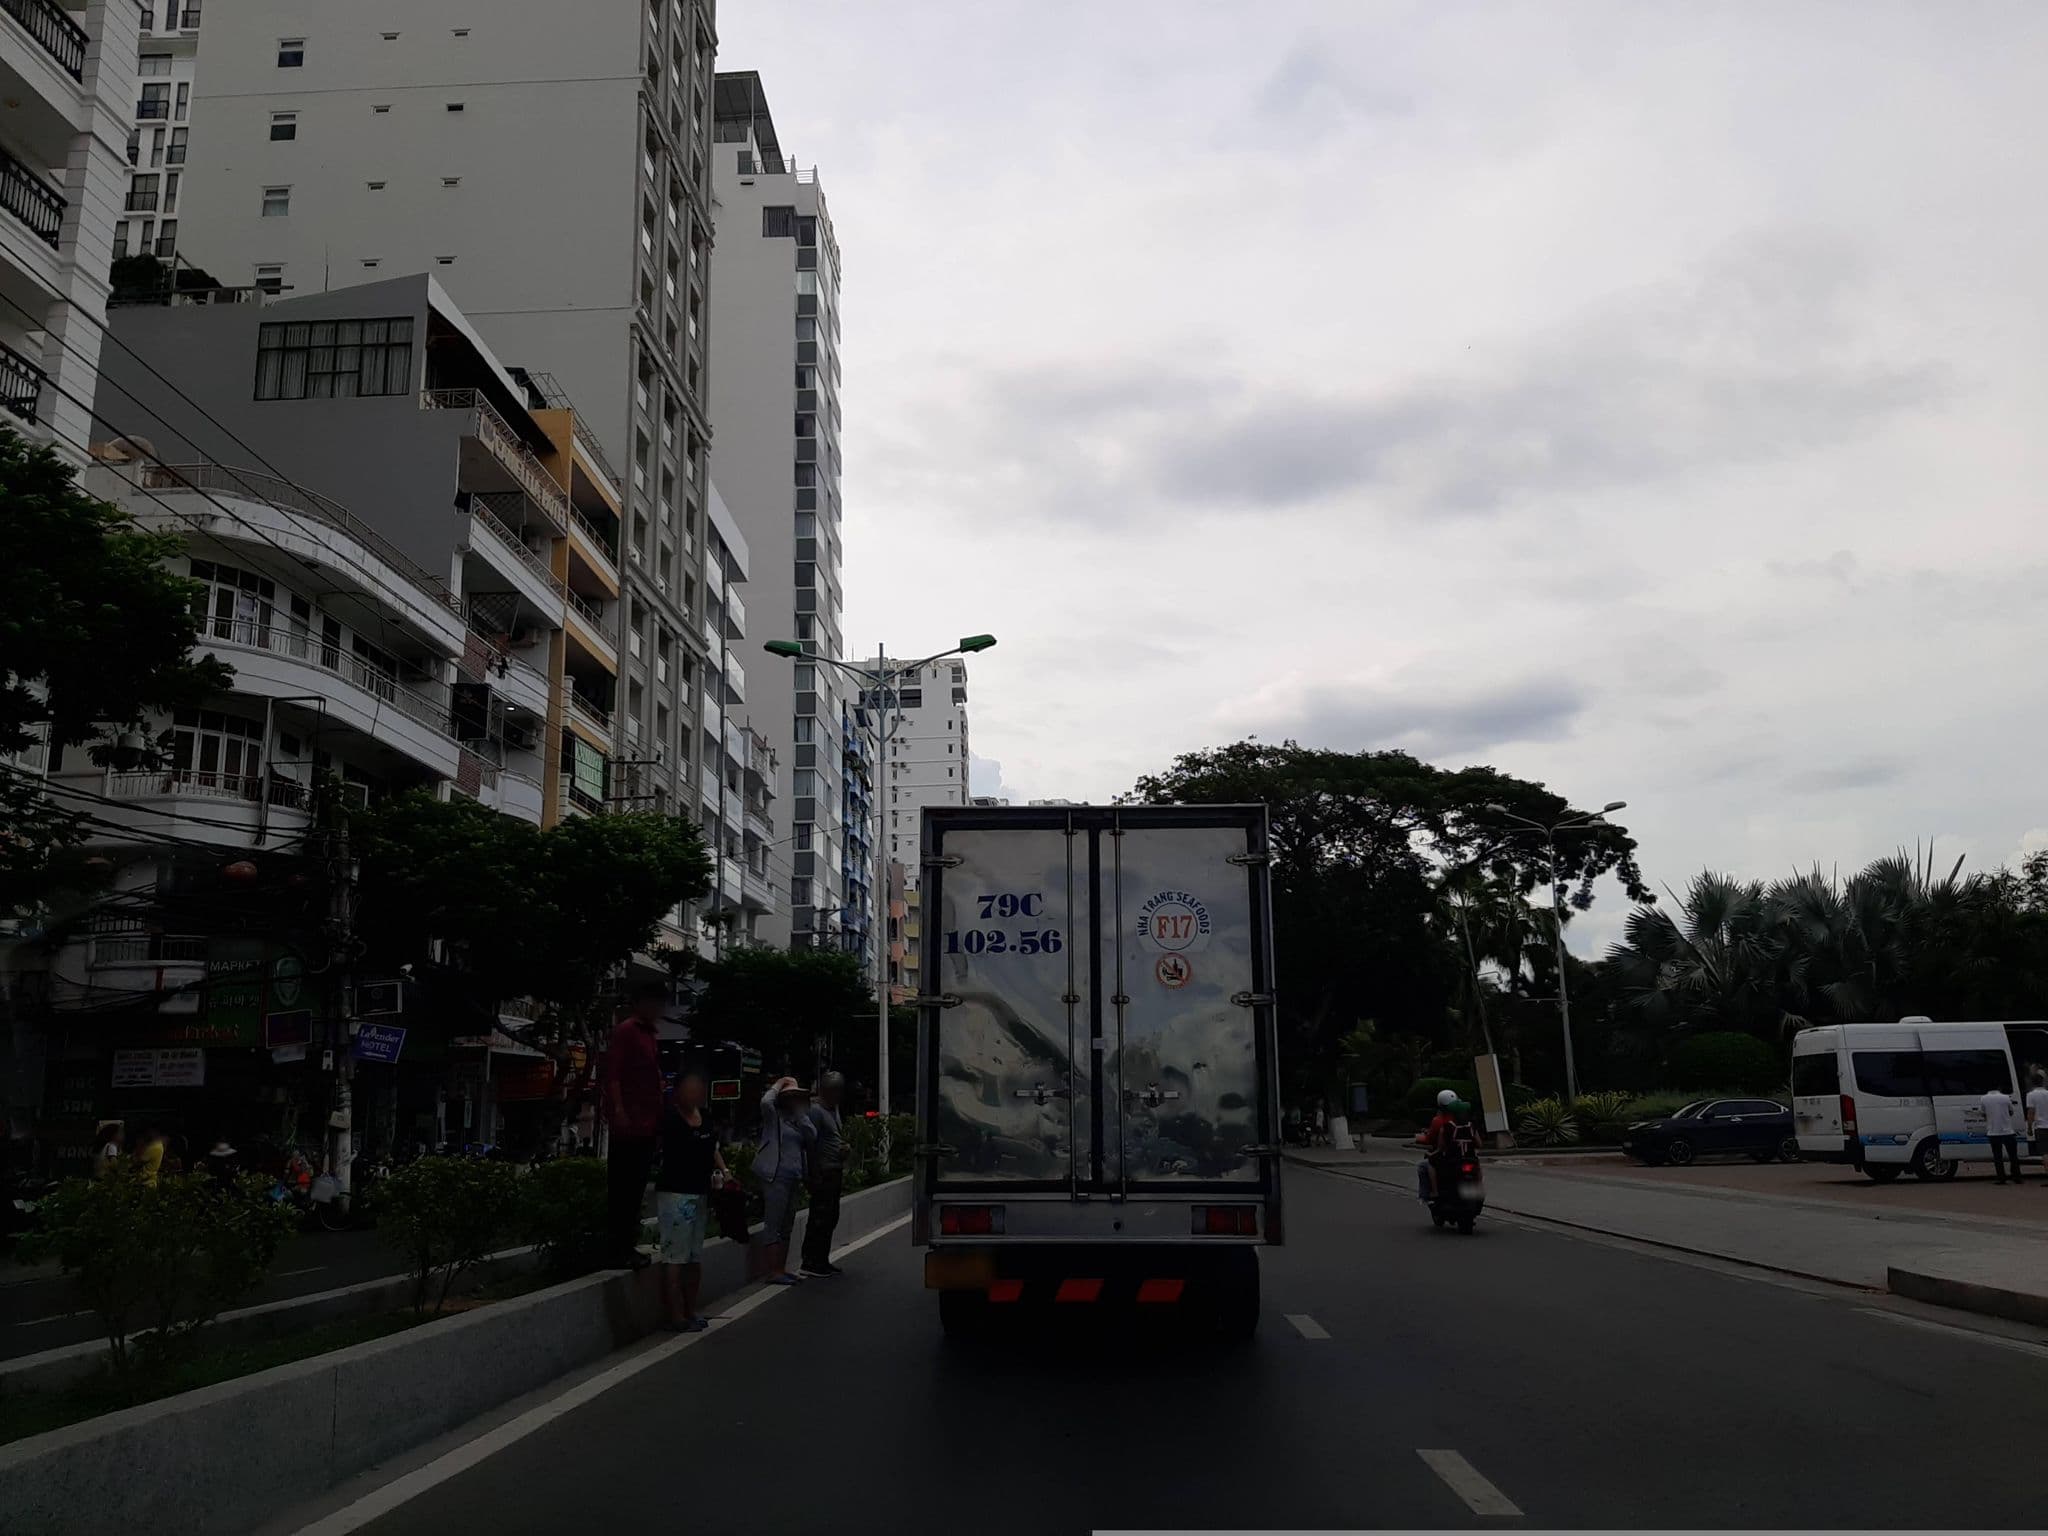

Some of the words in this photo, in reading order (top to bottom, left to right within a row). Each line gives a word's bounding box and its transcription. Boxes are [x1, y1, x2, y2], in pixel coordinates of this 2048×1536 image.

[977, 893, 1043, 919] 79C
[1142, 892, 1173, 913] TRANG
[1176, 892, 1210, 934] SEAFOODS
[1137, 916, 1149, 936] NHA
[1156, 915, 1192, 939] F17
[944, 930, 1062, 954] 102.56
